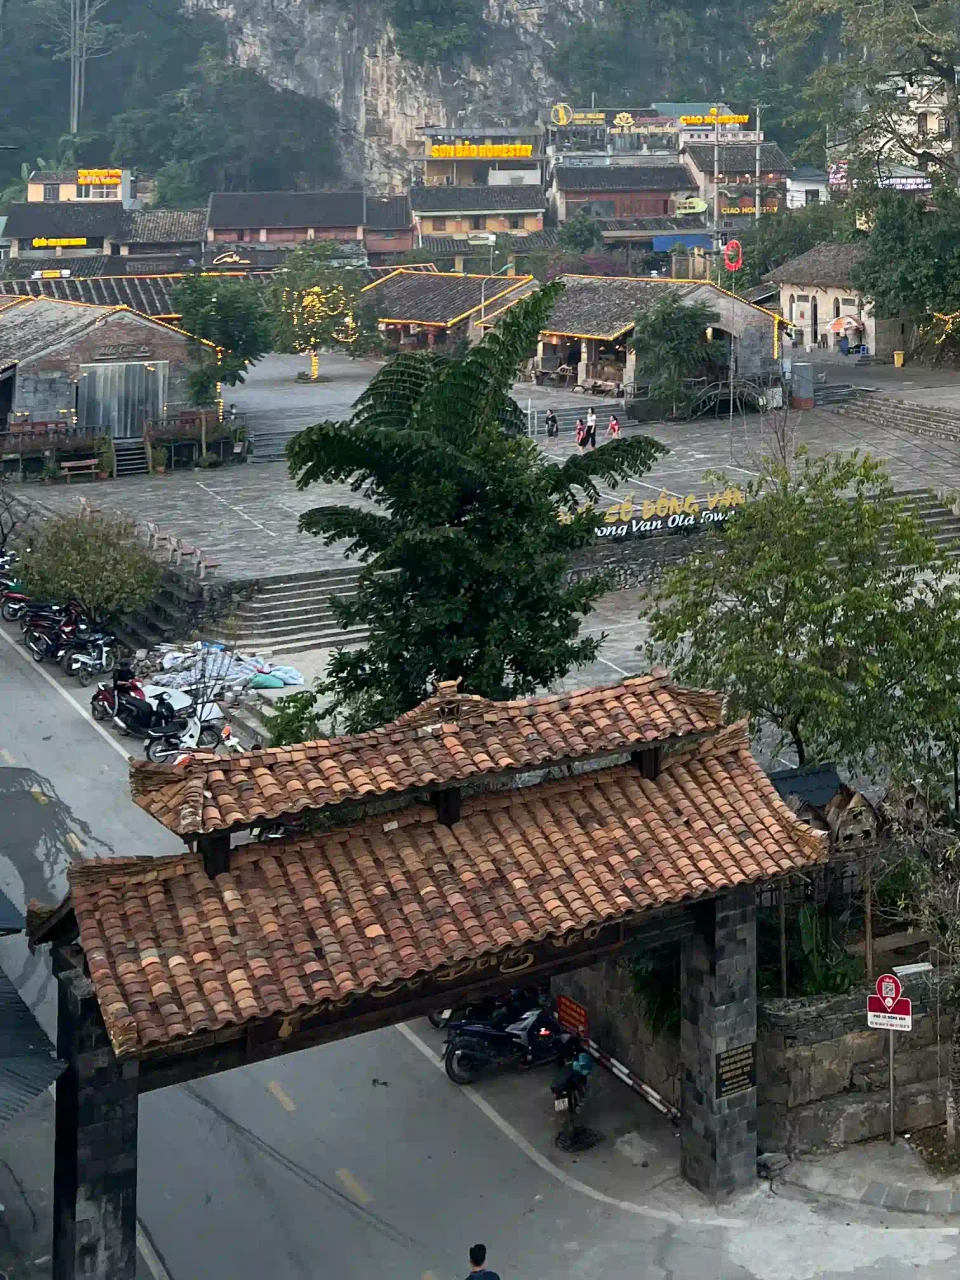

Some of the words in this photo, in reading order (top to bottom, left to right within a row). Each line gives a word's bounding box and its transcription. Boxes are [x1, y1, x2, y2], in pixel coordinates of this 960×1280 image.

[680, 115, 703, 124] CIAO
[480, 145, 532, 157] HOMESTAY
[632, 515, 662, 532] Van
[668, 514, 695, 528] Old
